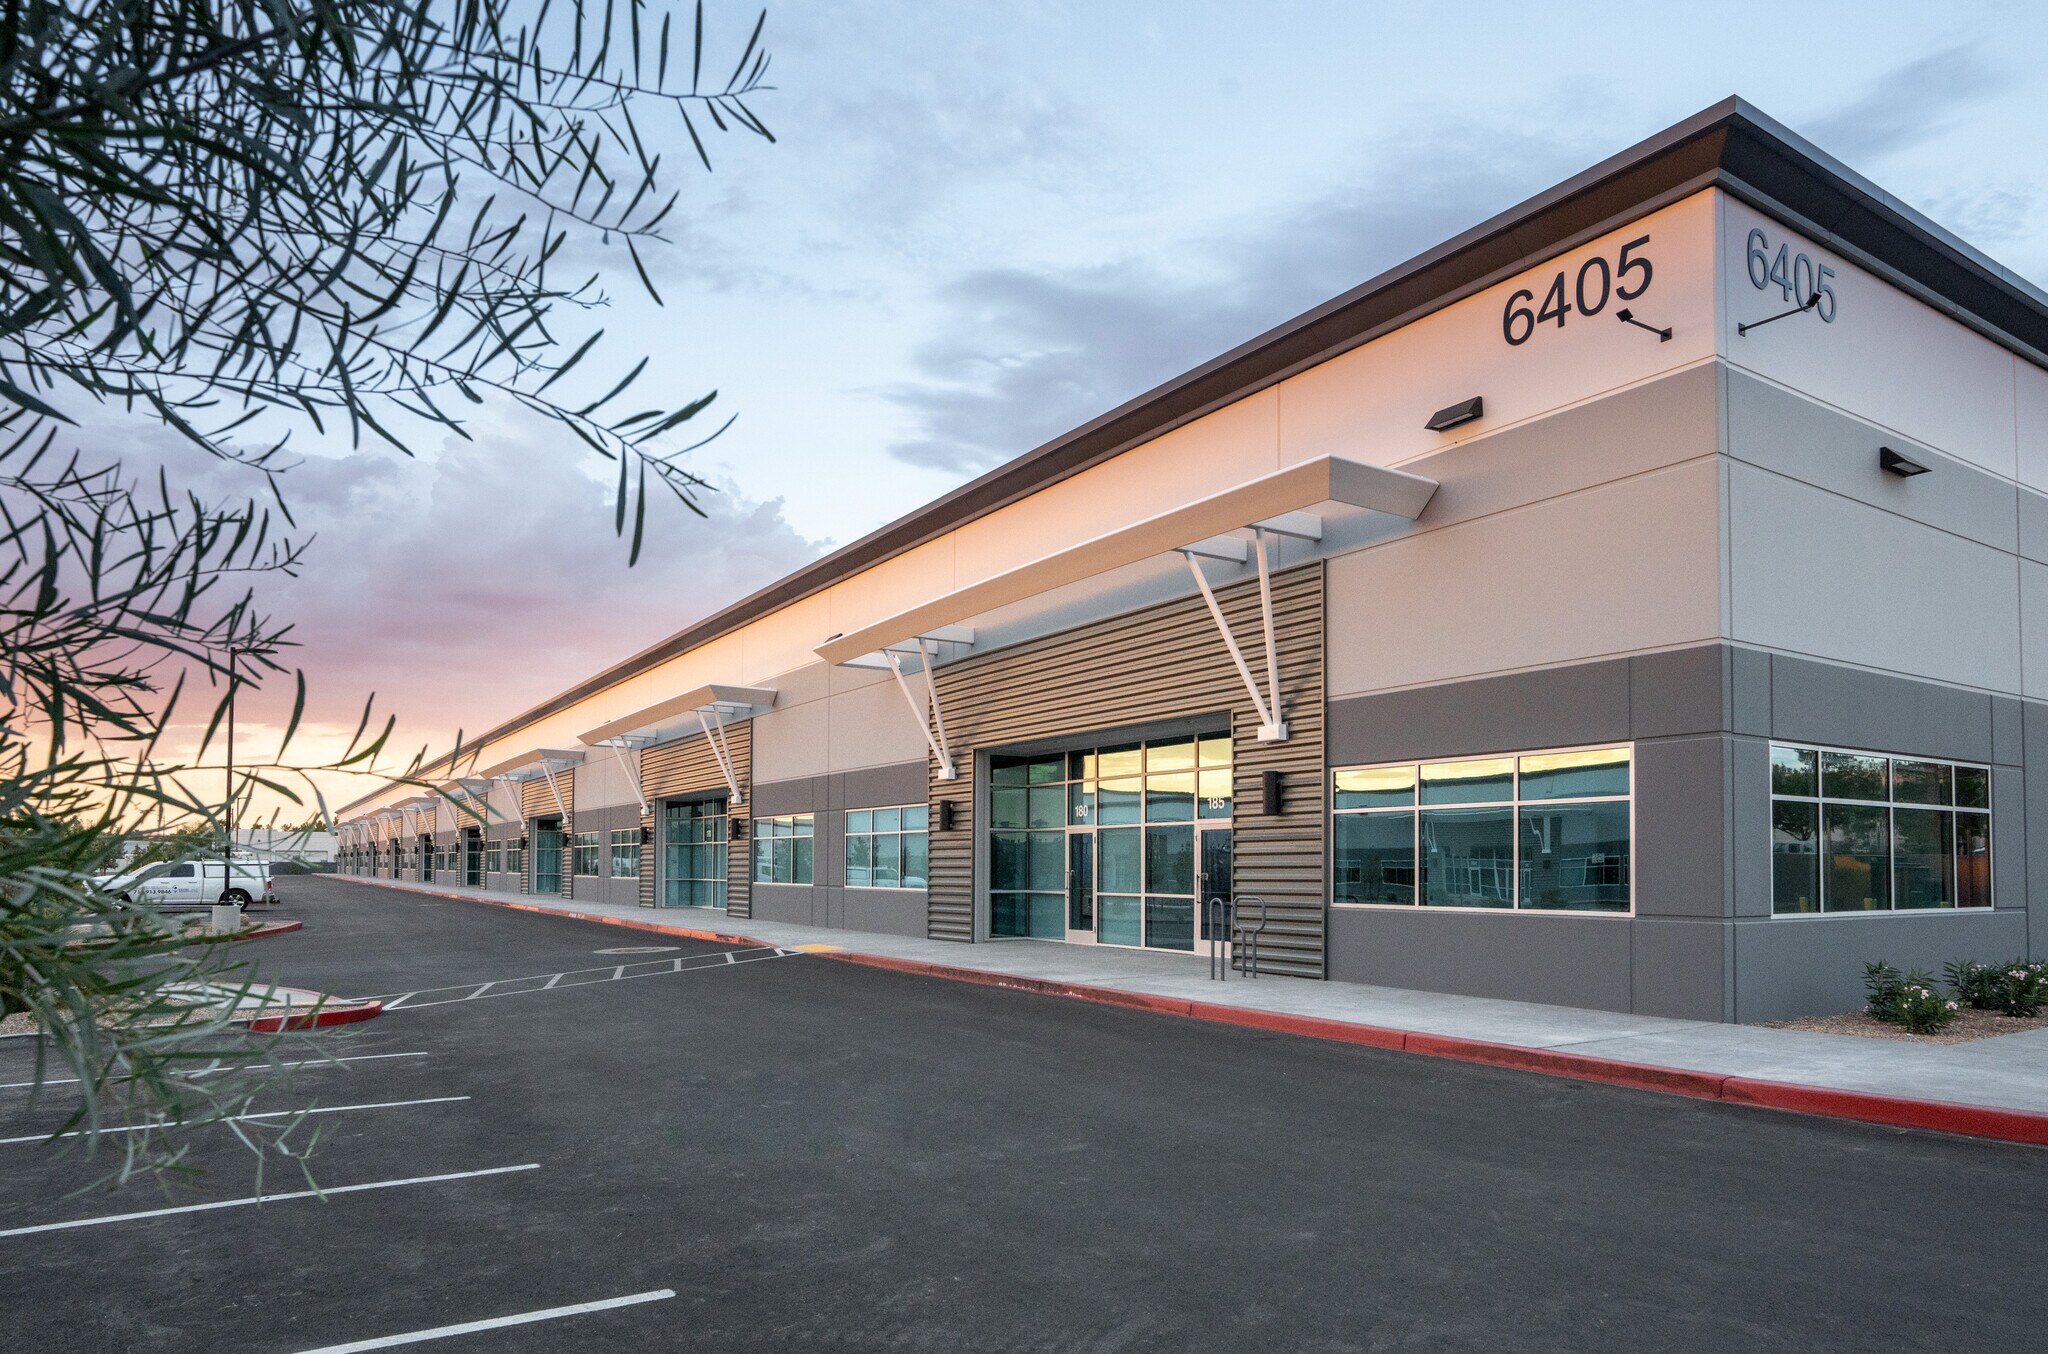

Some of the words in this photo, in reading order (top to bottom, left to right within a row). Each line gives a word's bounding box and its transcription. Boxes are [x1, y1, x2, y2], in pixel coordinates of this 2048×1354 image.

[1503, 234, 1654, 346] 6405
[1747, 228, 1837, 323] 6405
[1075, 804, 1089, 817] 180
[1207, 797, 1225, 810] 185
